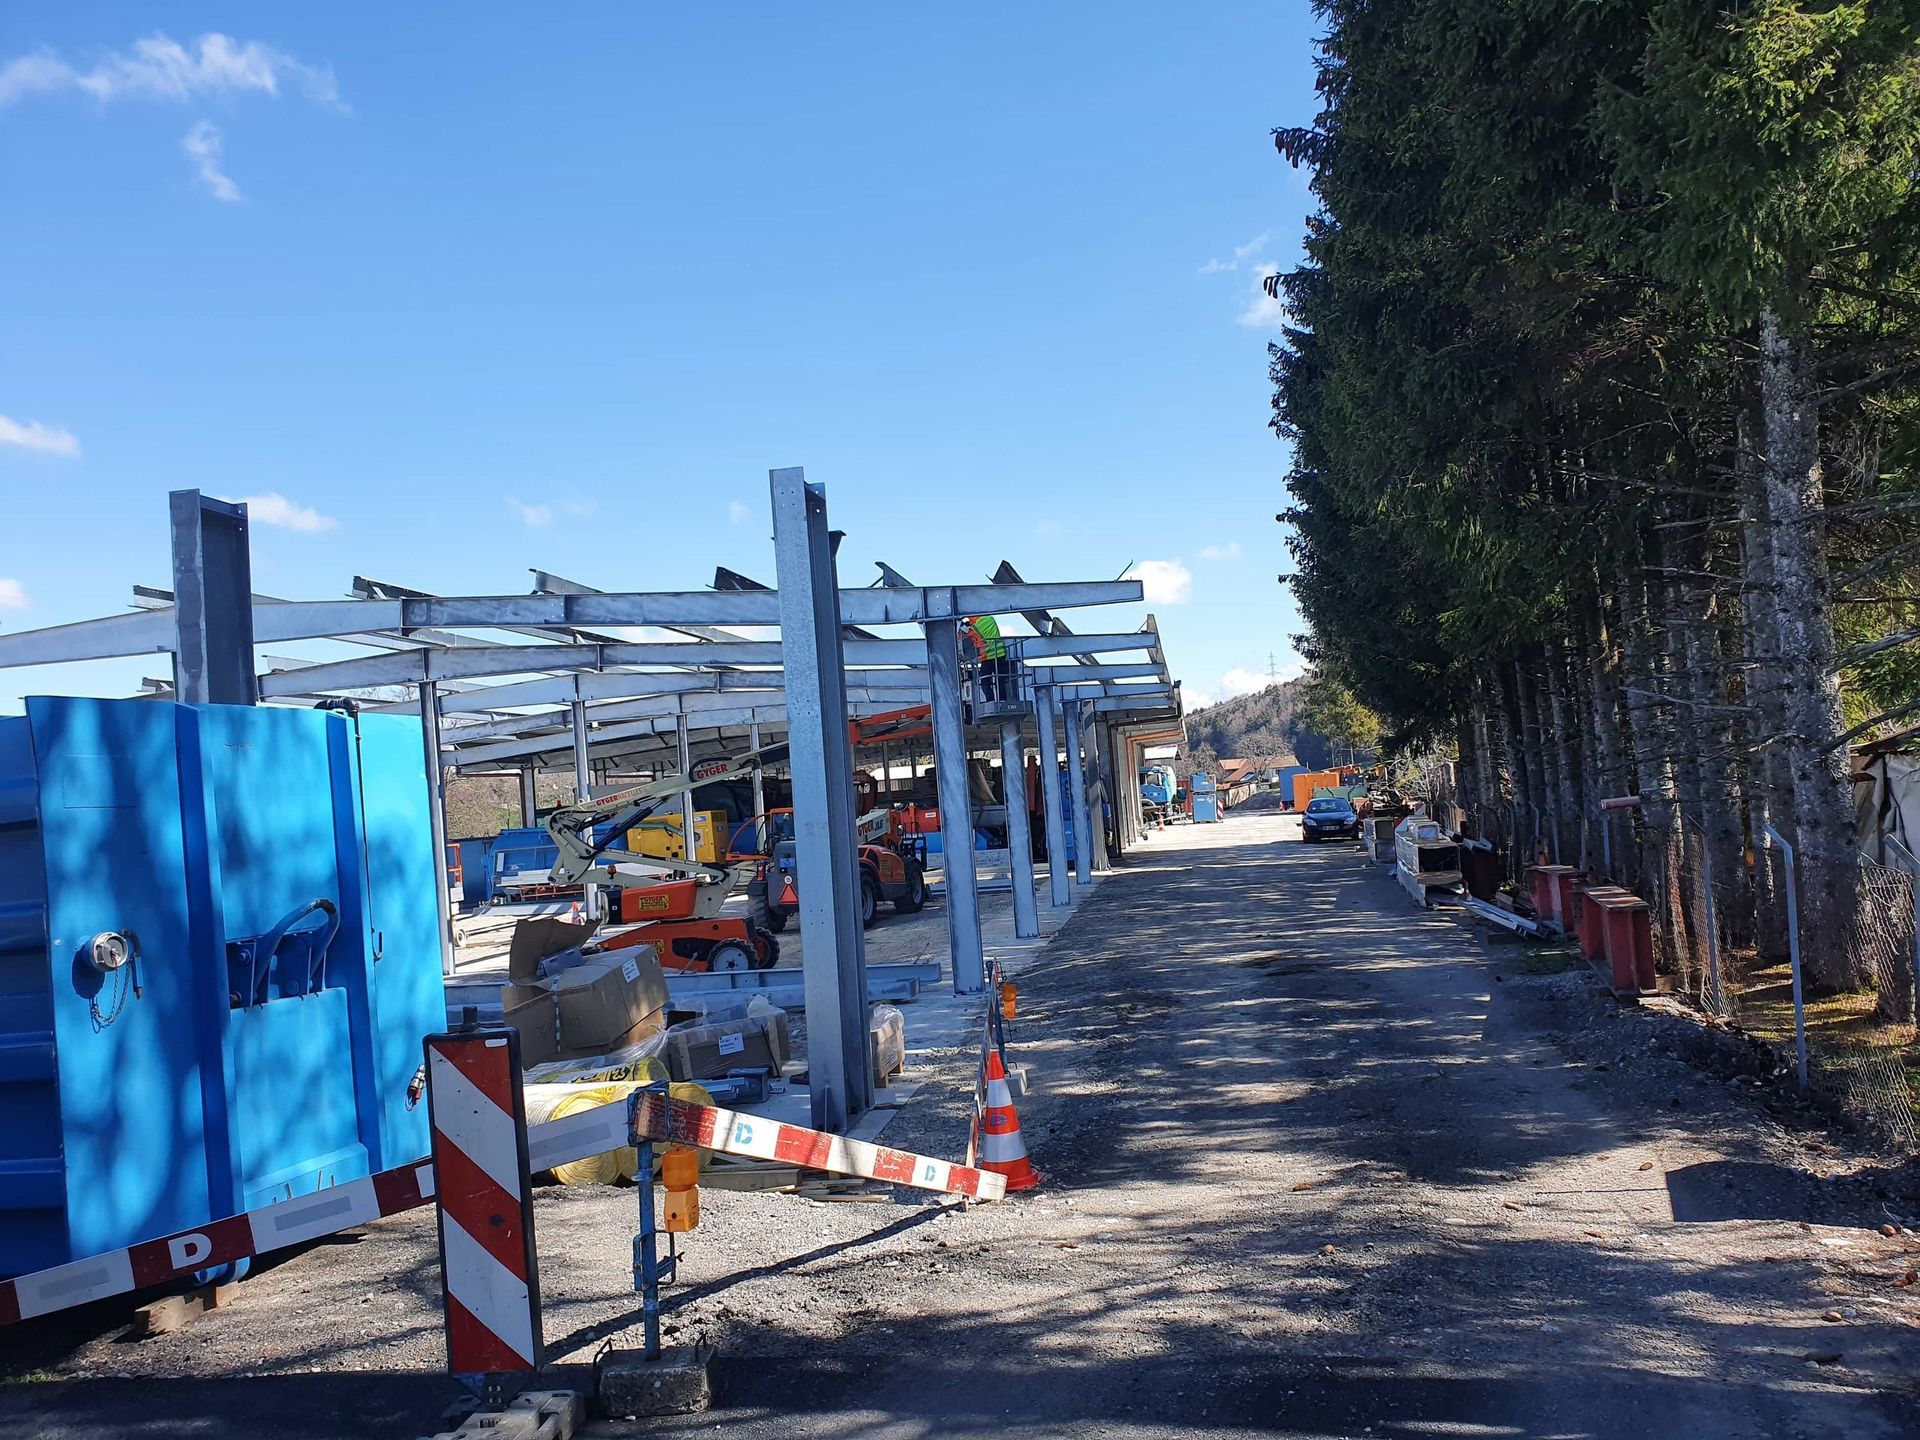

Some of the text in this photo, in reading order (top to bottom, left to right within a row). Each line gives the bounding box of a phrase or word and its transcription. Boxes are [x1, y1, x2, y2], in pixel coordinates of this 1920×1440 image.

[696, 763, 728, 780] GYGER
[734, 1122, 753, 1145] D
[924, 1165, 936, 1182] D
[168, 1233, 212, 1270] D
